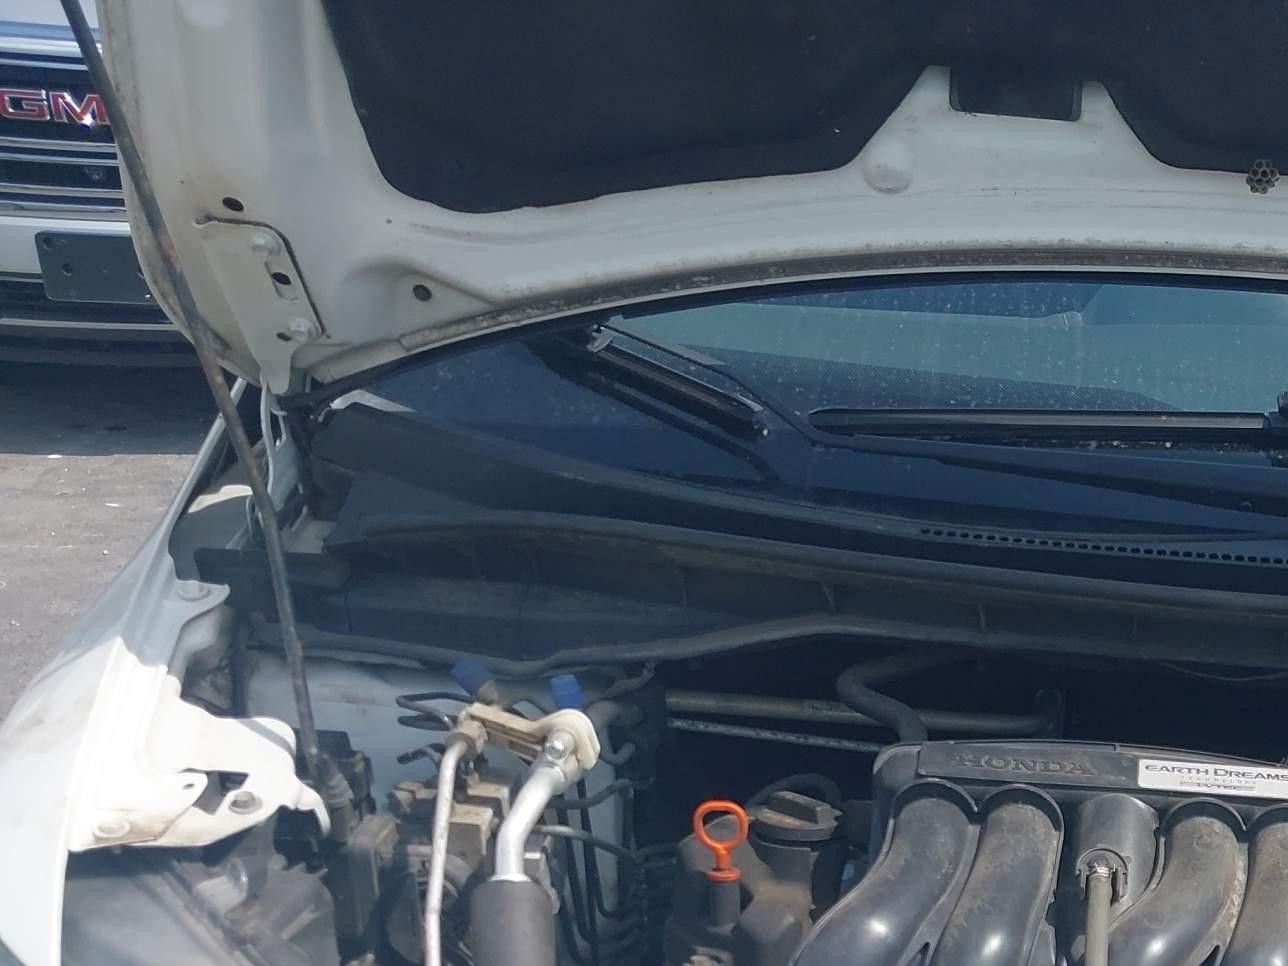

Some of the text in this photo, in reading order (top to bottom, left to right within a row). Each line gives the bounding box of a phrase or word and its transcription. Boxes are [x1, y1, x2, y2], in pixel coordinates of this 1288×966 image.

[0, 88, 110, 125] GM
[955, 753, 1097, 776] HONDA
[1145, 764, 1209, 776] EARTH
